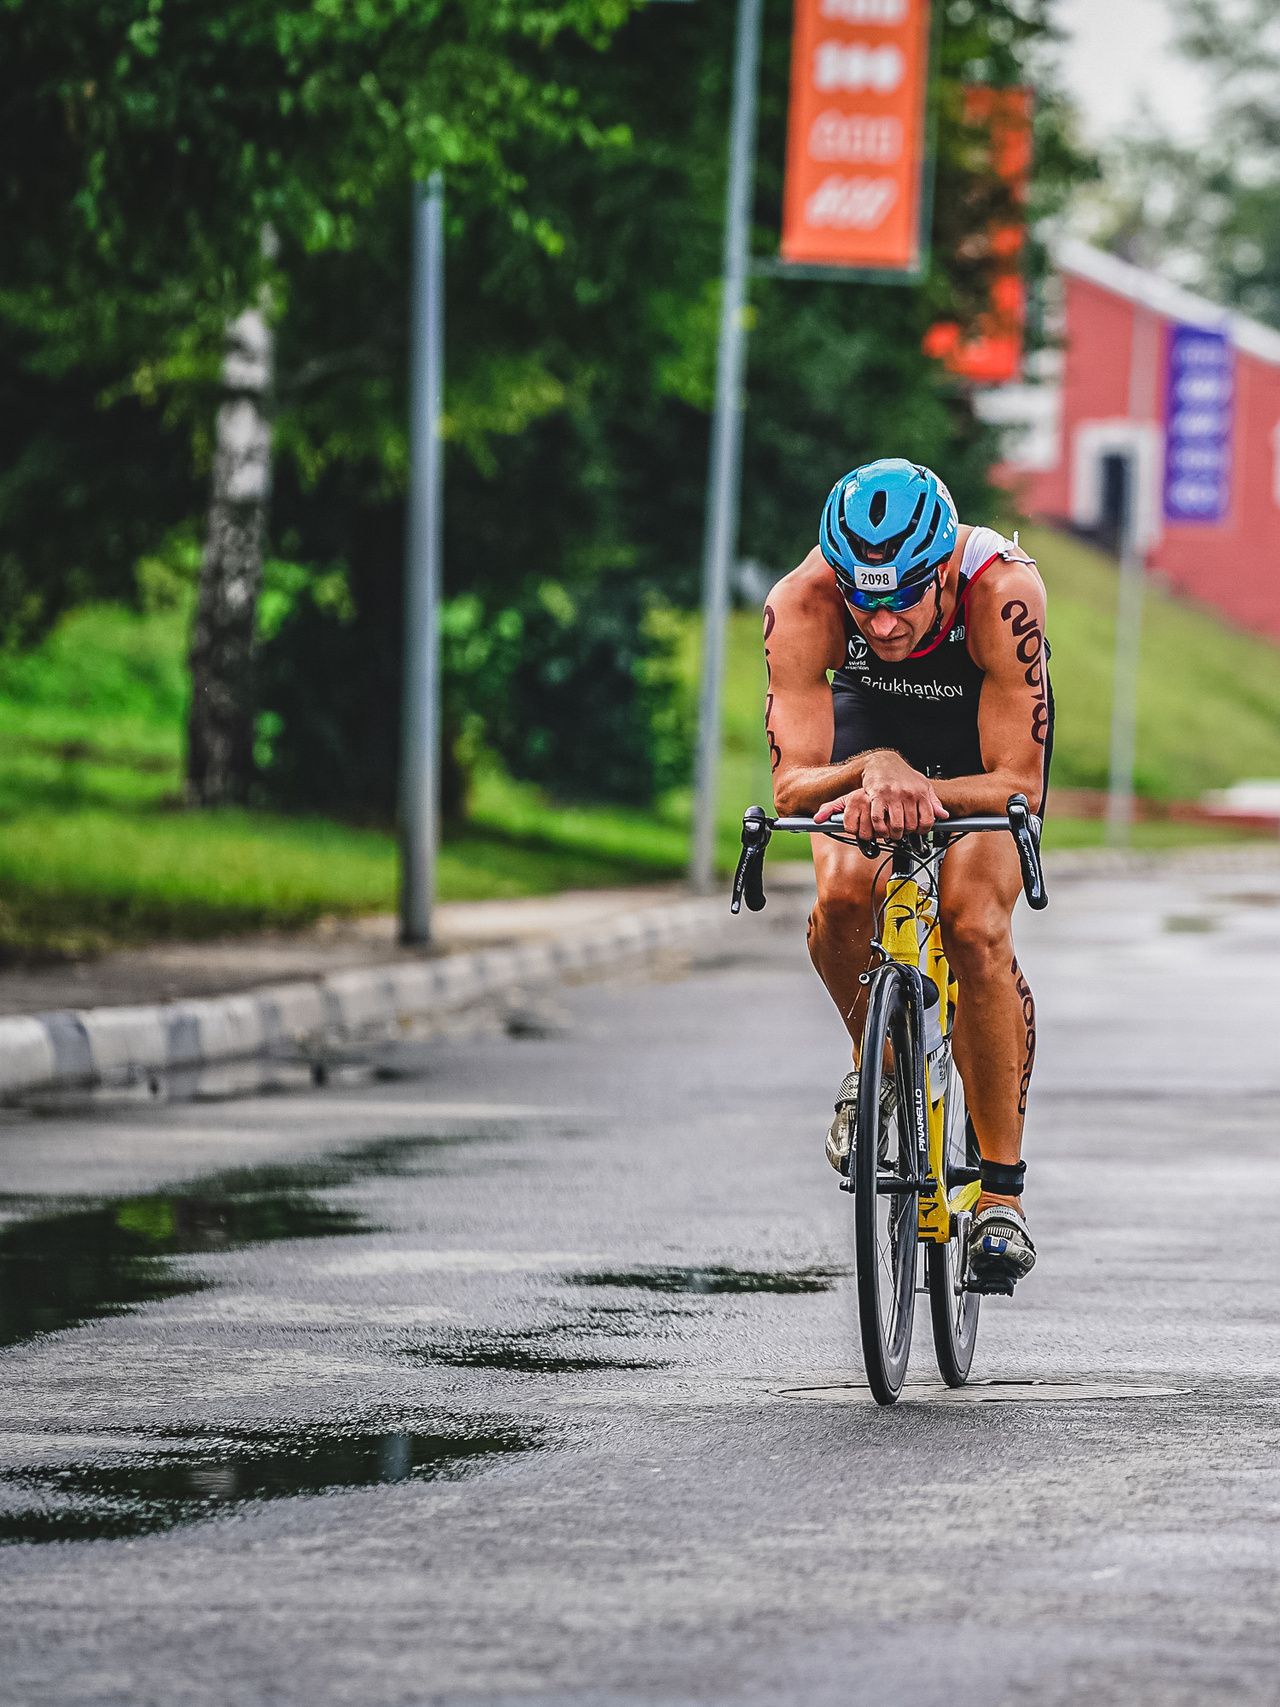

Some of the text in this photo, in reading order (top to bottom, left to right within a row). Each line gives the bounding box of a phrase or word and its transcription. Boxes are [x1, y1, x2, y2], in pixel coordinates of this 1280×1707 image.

[861, 572, 890, 585] 2098
[861, 676, 963, 698] Briukhankov
[915, 1088, 927, 1152] PINARELLO
